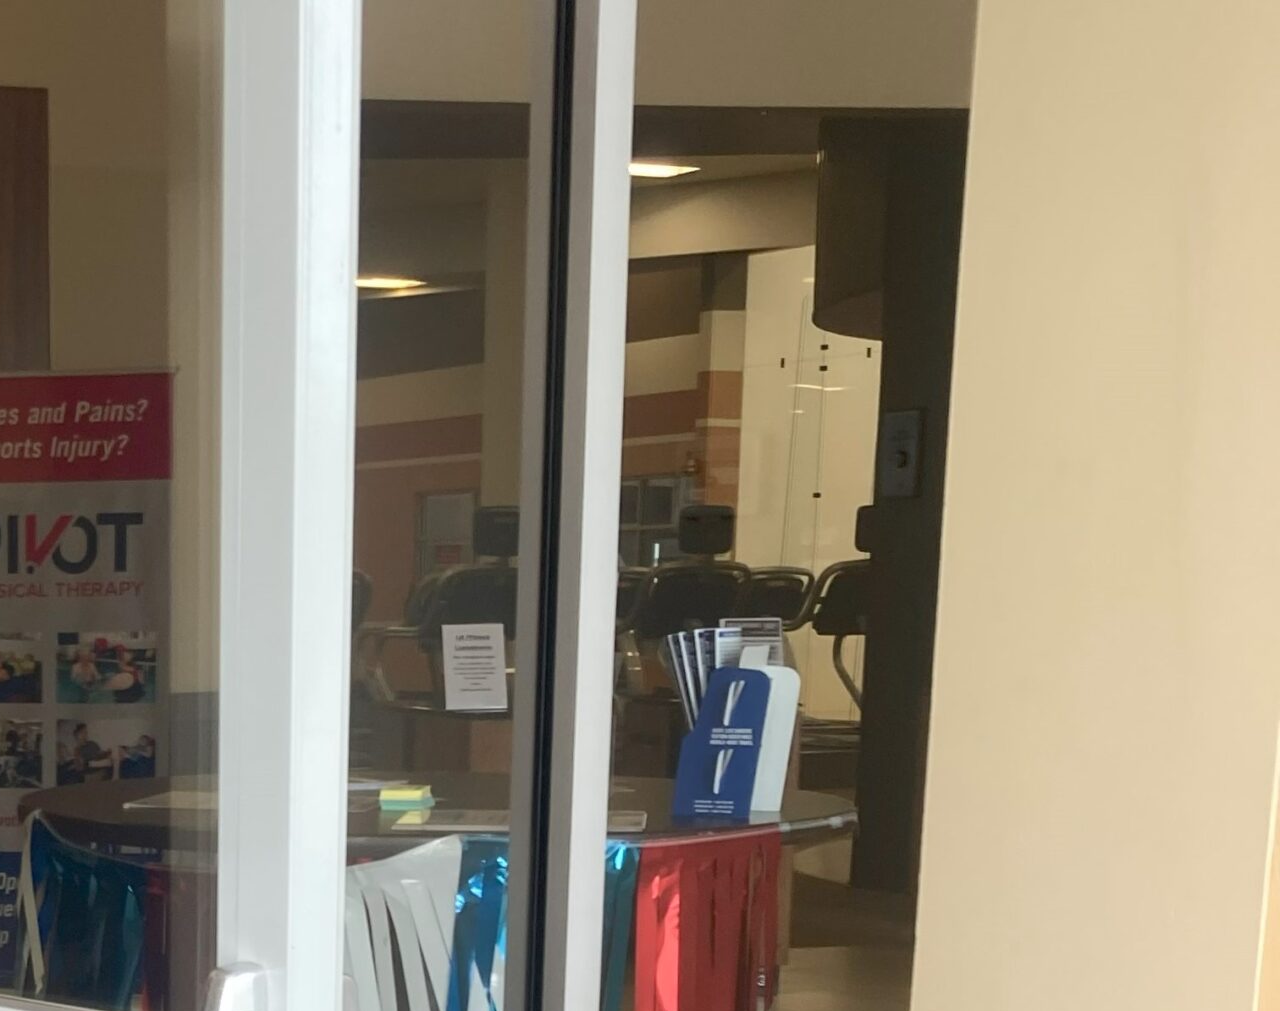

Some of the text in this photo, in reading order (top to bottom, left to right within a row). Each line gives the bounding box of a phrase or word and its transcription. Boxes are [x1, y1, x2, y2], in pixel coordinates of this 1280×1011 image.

[27, 403, 66, 425] and
[74, 399, 148, 423] Pains?
[50, 434, 129, 463] Injury?
[55, 580, 145, 598] THERAPY
